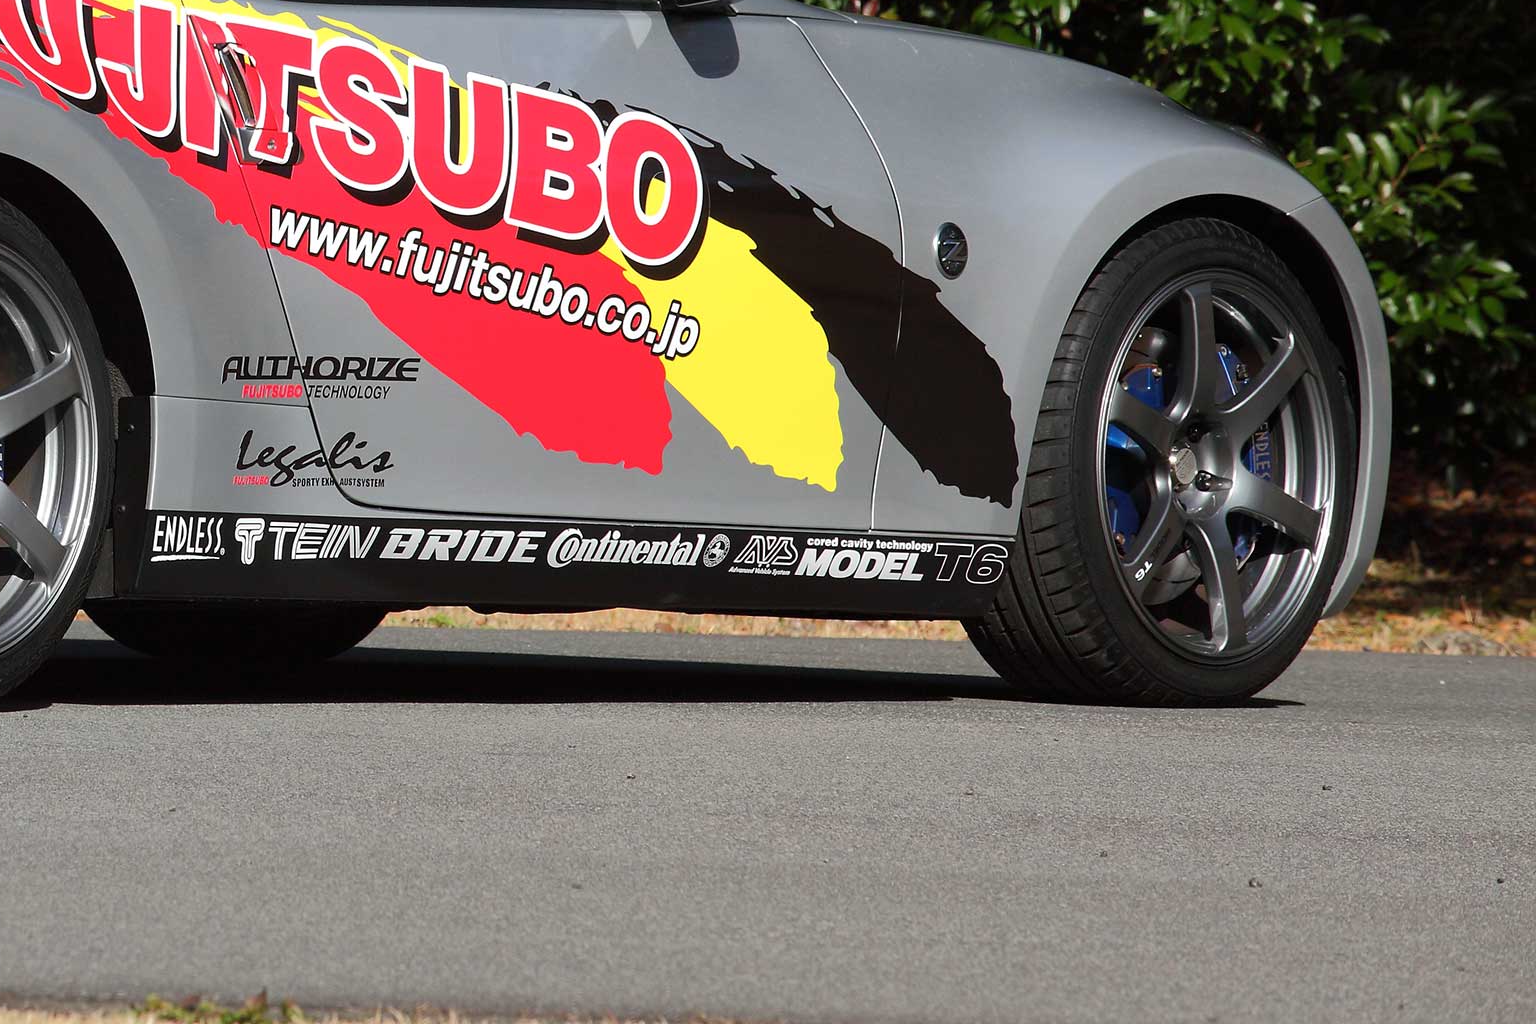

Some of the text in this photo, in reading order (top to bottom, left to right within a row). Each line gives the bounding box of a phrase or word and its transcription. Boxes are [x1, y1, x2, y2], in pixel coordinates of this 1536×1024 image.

[269, 203, 702, 360] www.fujitsubo.co.jp
[221, 355, 421, 384] AUTHORIZE
[241, 383, 392, 400] FUJITSUBO TECHNOLOGY
[235, 429, 394, 487] Legalis
[292, 477, 320, 488] SPORTY
[152, 515, 224, 554] ENDLESS
[268, 521, 381, 560] TEIN
[378, 527, 547, 564] BRIDE
[546, 527, 707, 568] Continental
[806, 536, 934, 553] cored cavity technology
[794, 542, 1009, 585] MODEL T6
[1134, 560, 1153, 582] T6
